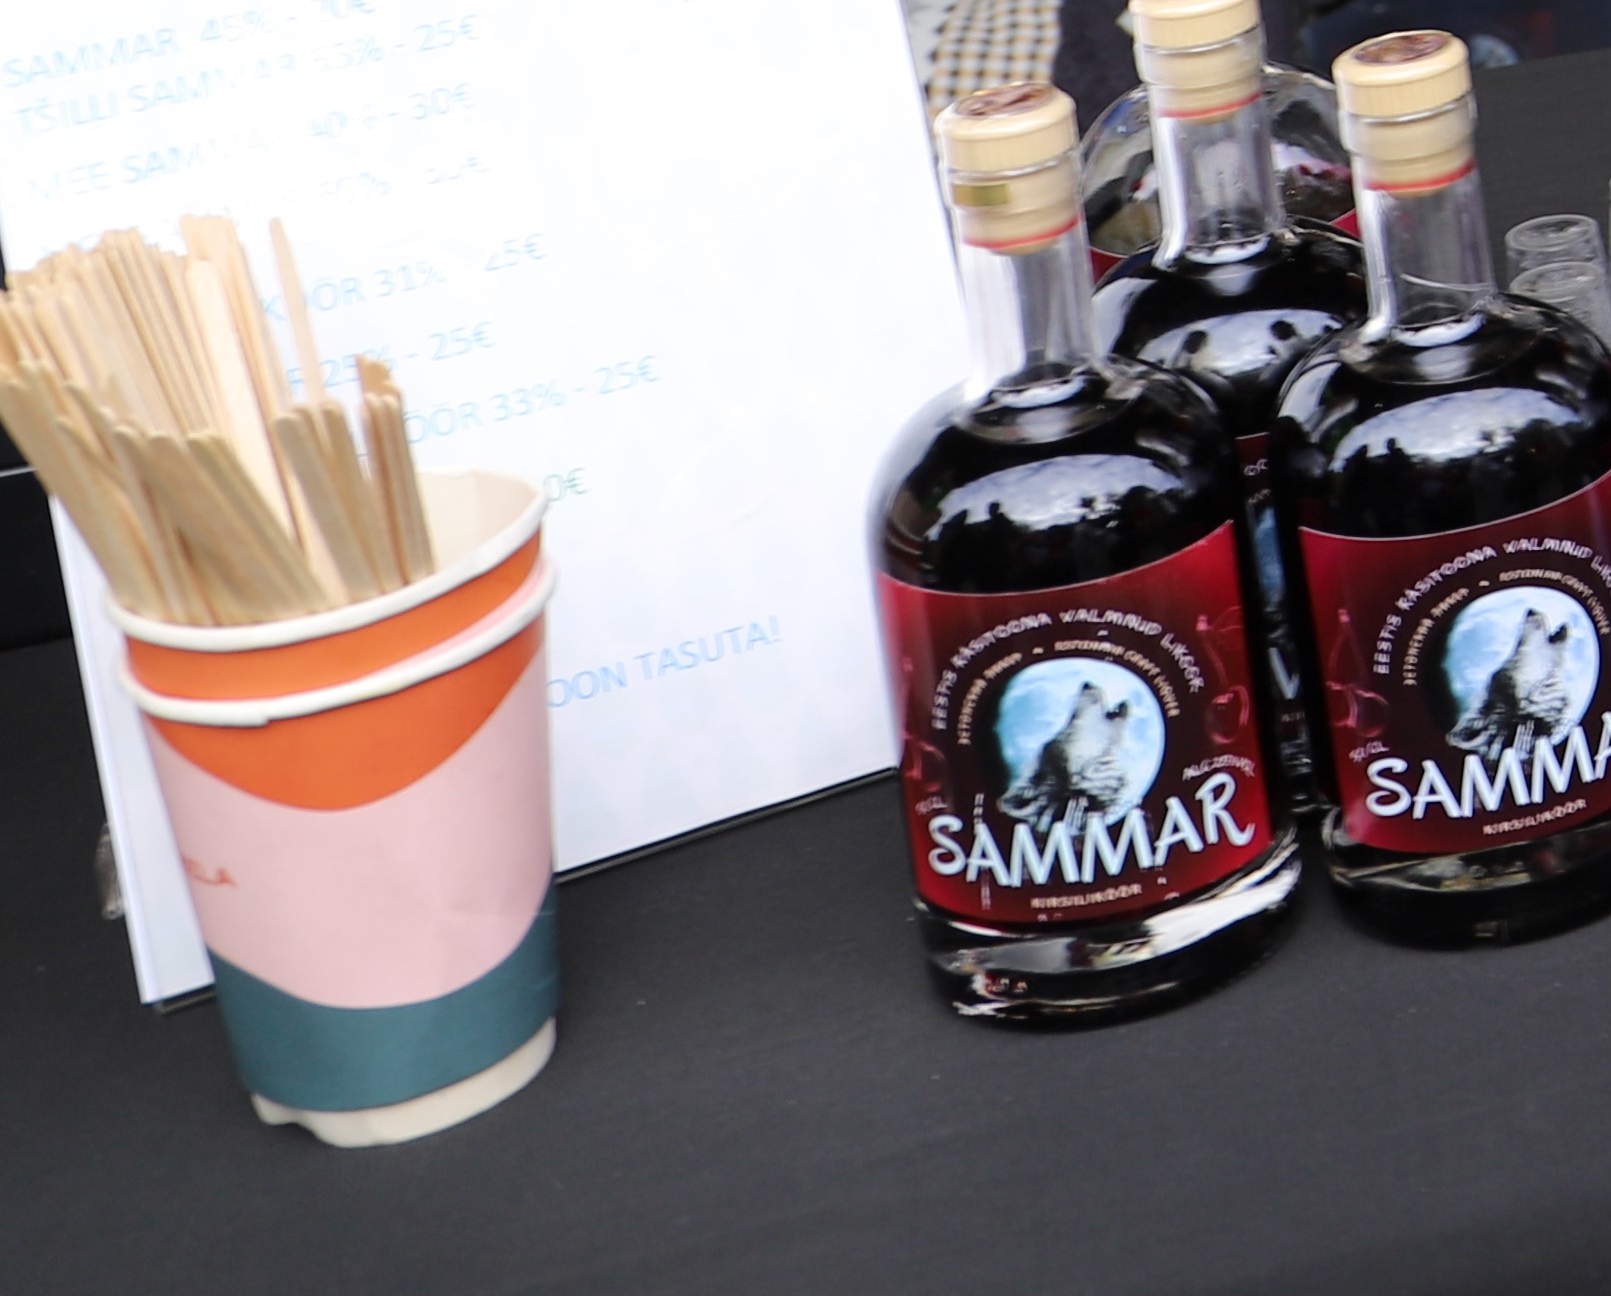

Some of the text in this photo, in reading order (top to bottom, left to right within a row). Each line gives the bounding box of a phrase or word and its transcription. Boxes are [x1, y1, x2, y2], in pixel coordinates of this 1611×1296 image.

[3, 27, 182, 89] SAMMAR
[414, 13, 480, 55] 25€
[411, 80, 475, 120] 30€
[377, 260, 448, 298] 31%
[429, 320, 497, 364] 25€
[489, 379, 566, 421] 33%
[595, 353, 663, 397] 25€
[635, 613, 783, 681] TASUTA!
[932, 670, 958, 730] EESTIS
[1059, 608, 1162, 635] VALMINUD
[1373, 614, 1401, 674] EESTIS
[929, 771, 1254, 888] SAMMAR
